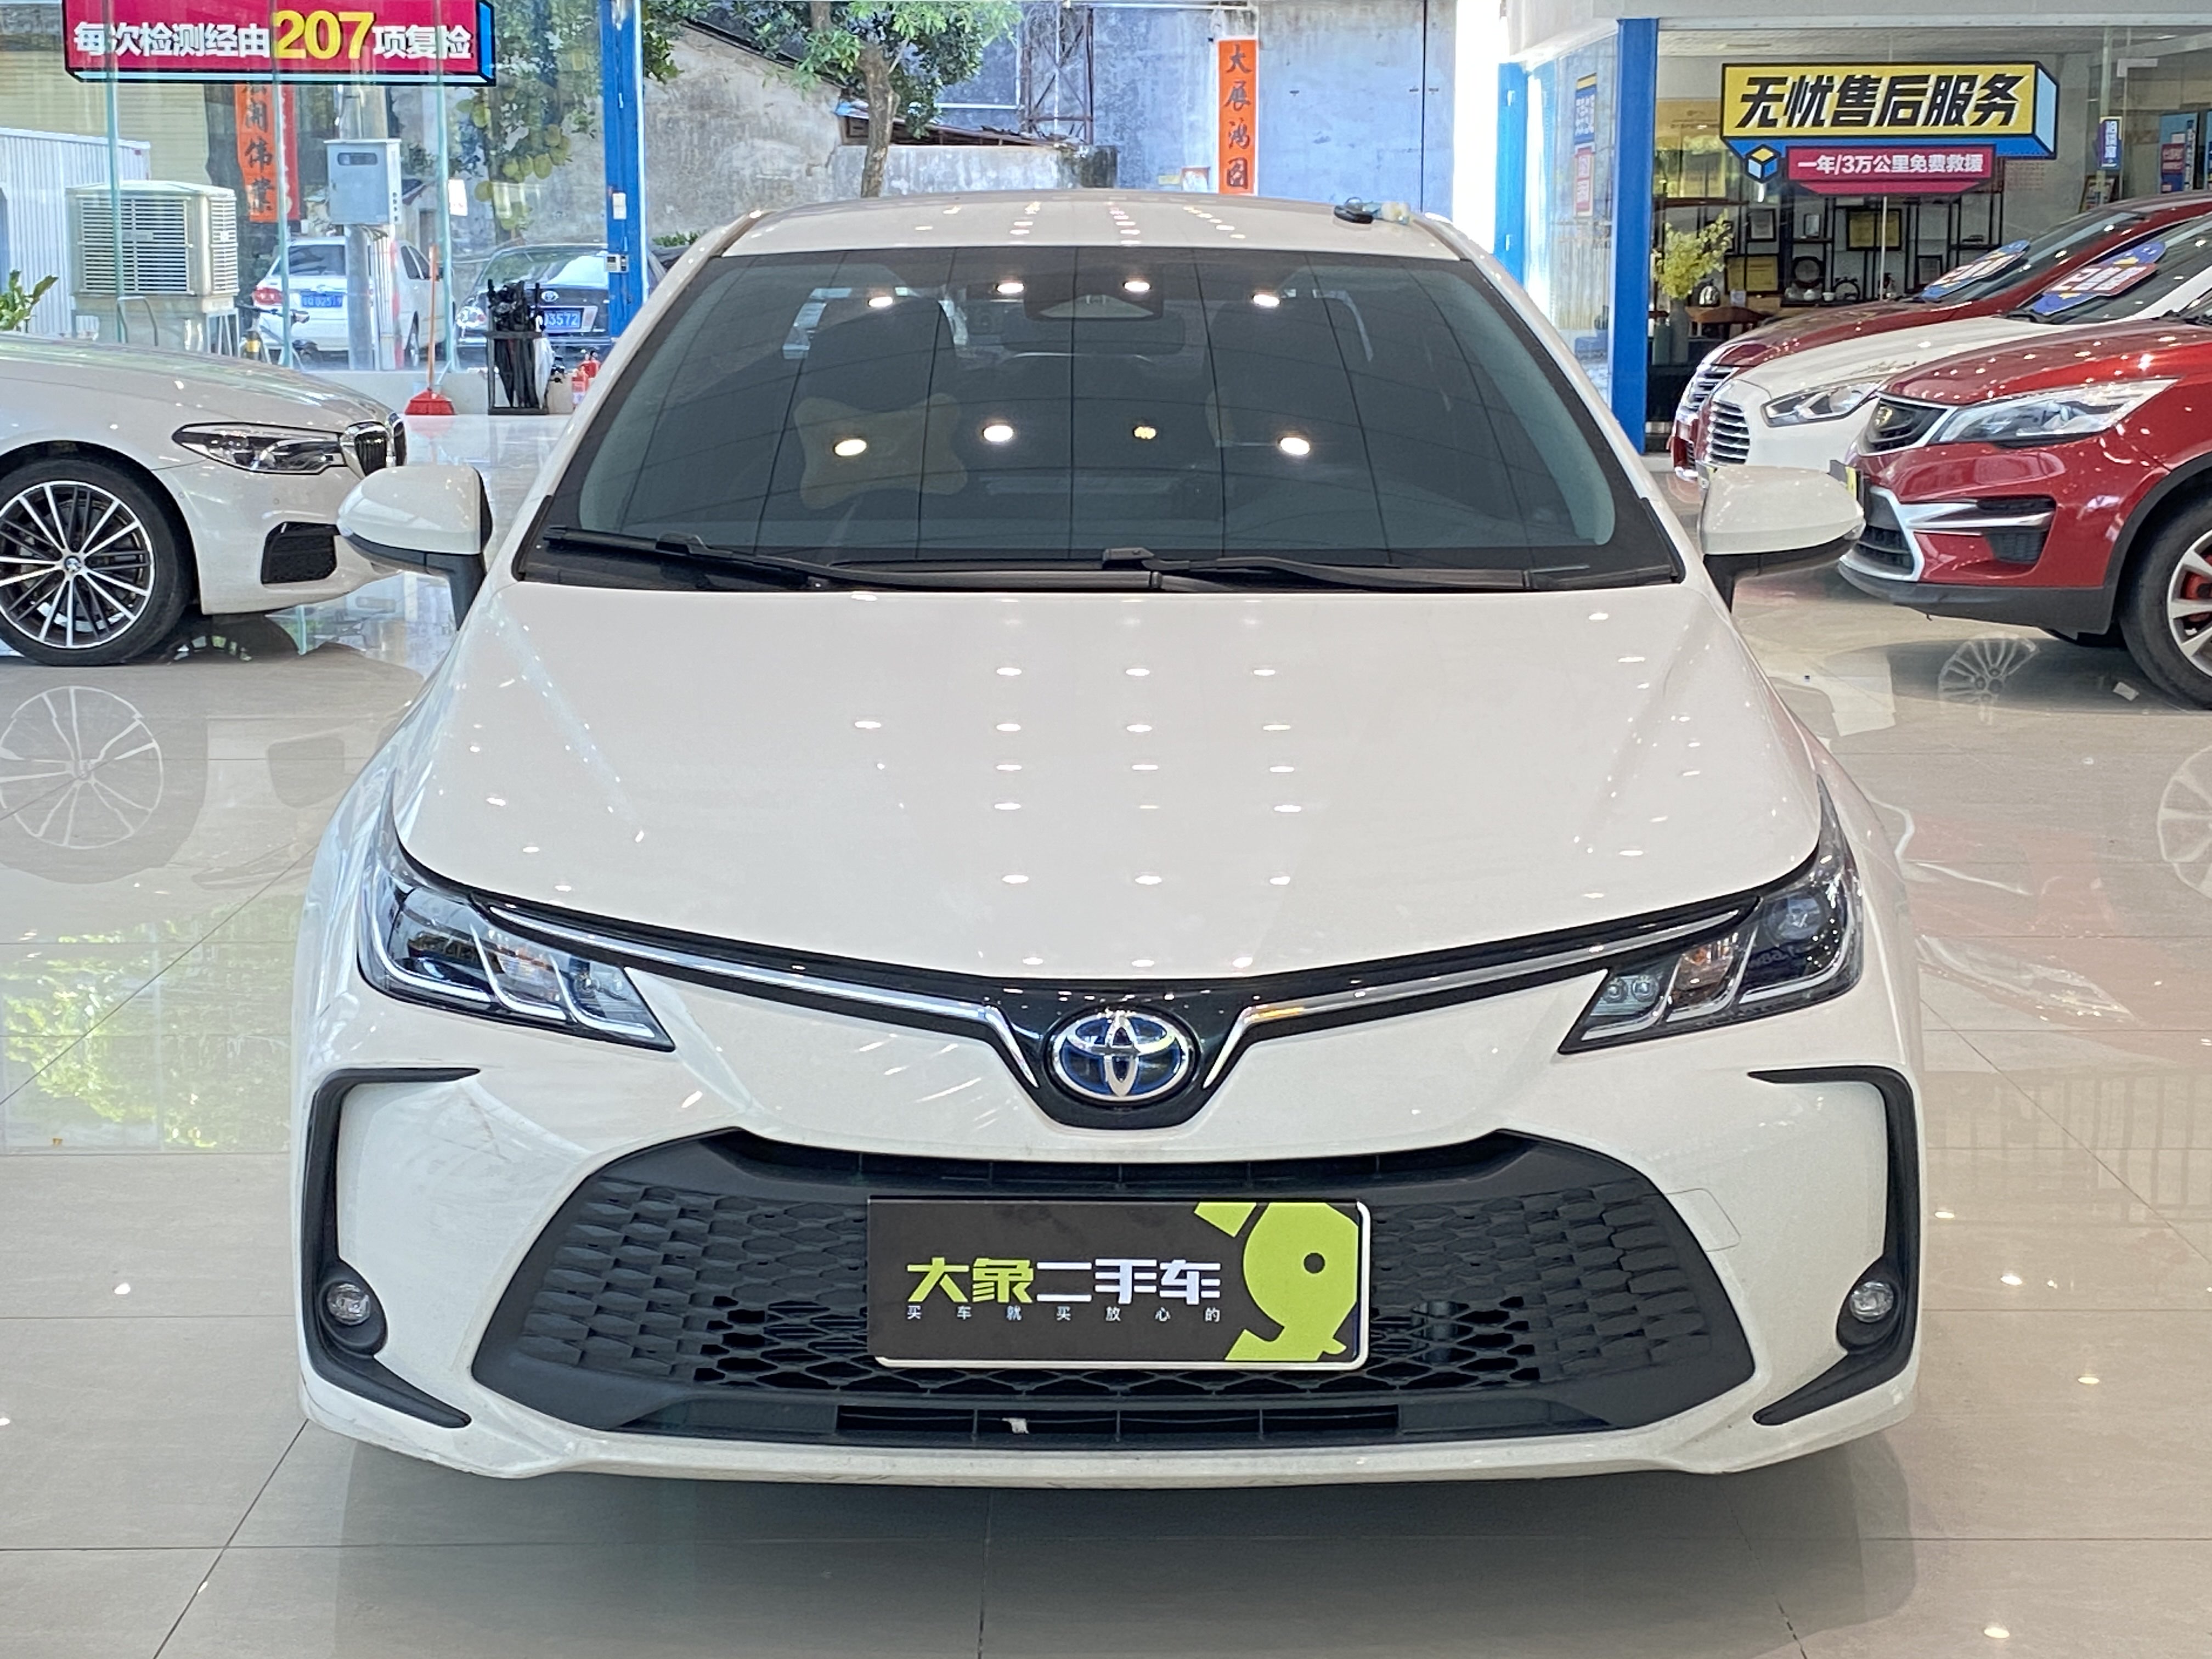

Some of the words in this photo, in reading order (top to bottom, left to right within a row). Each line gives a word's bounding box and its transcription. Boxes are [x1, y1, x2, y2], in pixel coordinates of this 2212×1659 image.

[74, 10, 472, 59] 每次检测经由207项复检
[1734, 73, 2027, 129] 无忧售后服务
[1797, 154, 1984, 175] 一年/3万公里免费救援
[906, 1257, 1221, 1305] 大象二手车
[907, 1305, 1221, 1323] 买车就买放心的
